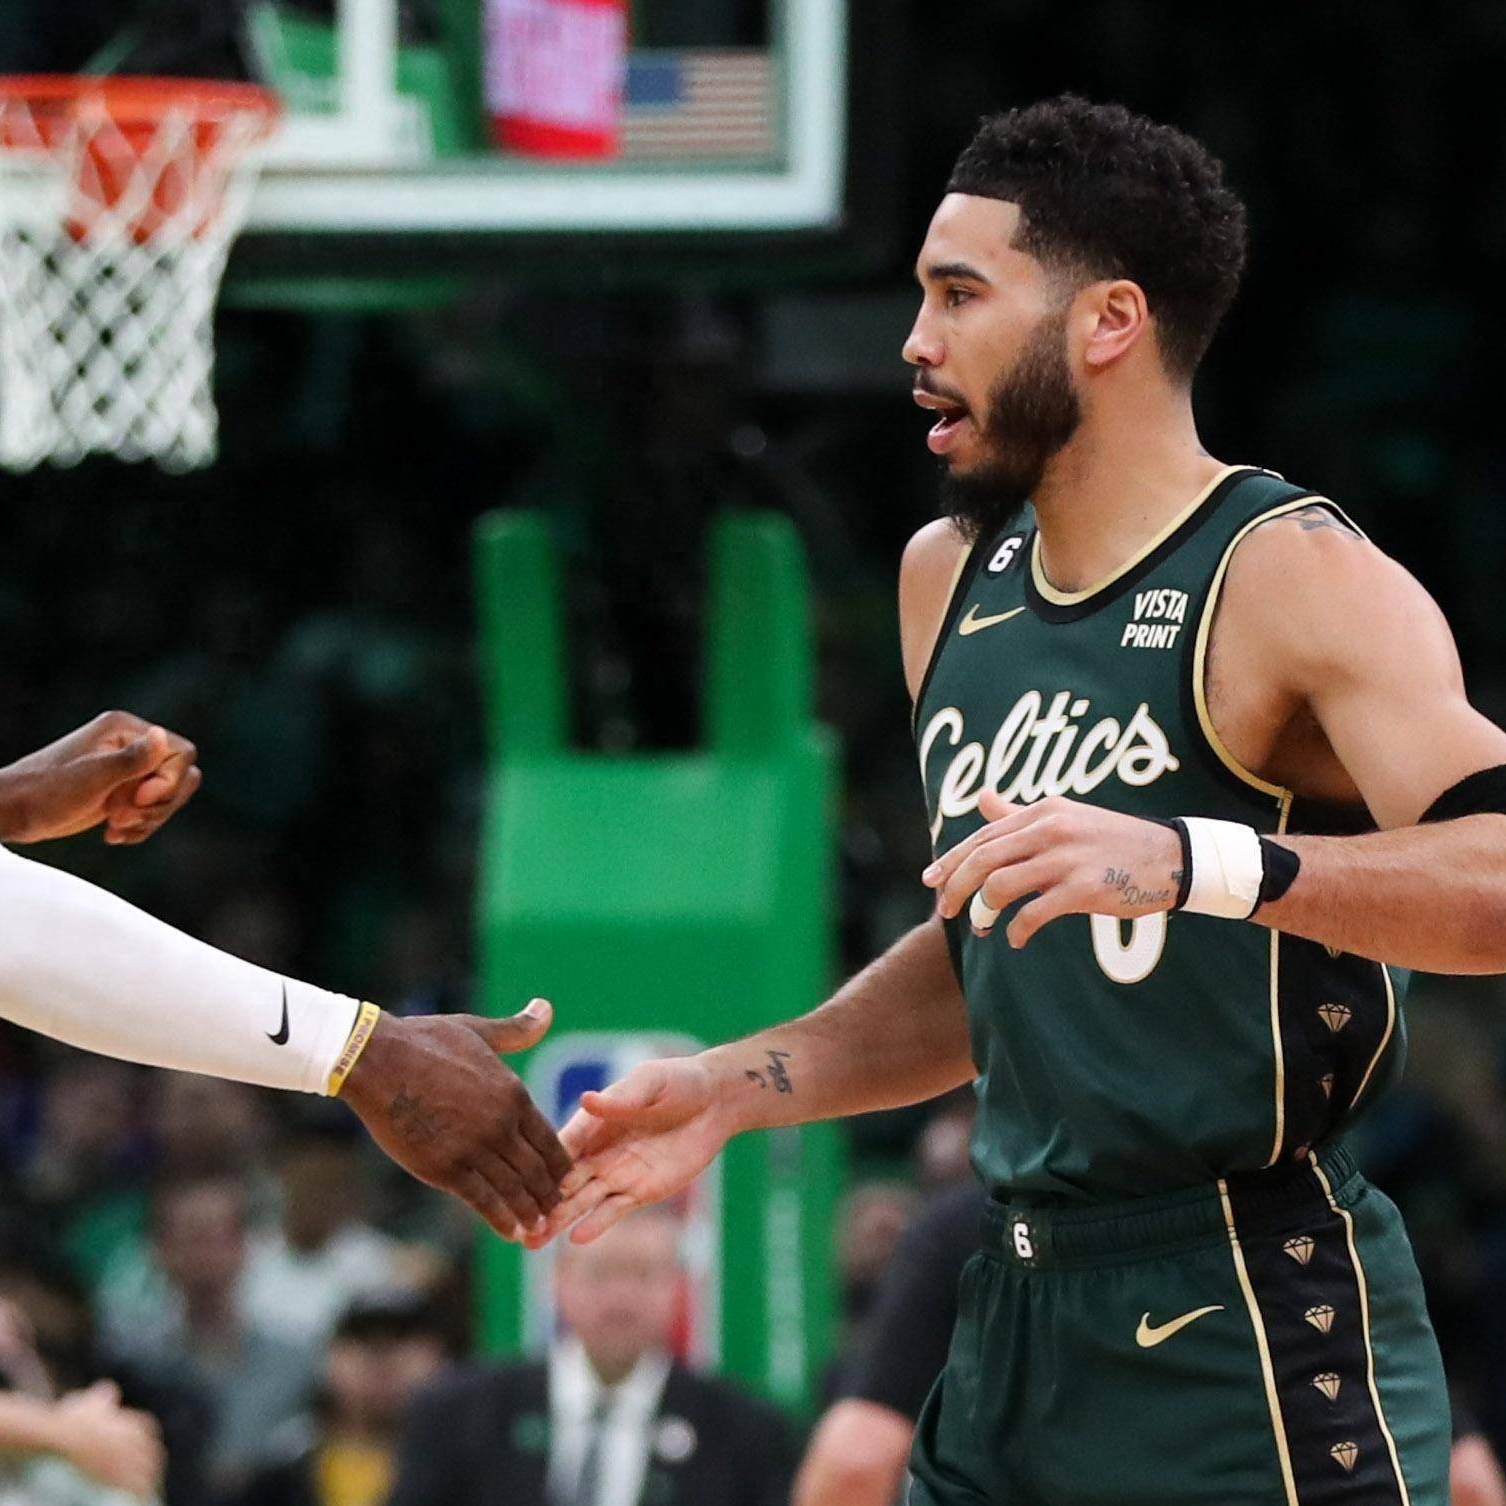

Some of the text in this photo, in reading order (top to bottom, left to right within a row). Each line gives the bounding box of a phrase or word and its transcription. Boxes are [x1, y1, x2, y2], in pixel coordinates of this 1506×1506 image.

[987, 537, 1023, 573] 6
[1133, 588, 1189, 624] VISTA
[1120, 623, 1181, 649] PRINT
[920, 690, 1180, 846] Celtics
[1013, 1222, 1034, 1258] 6
